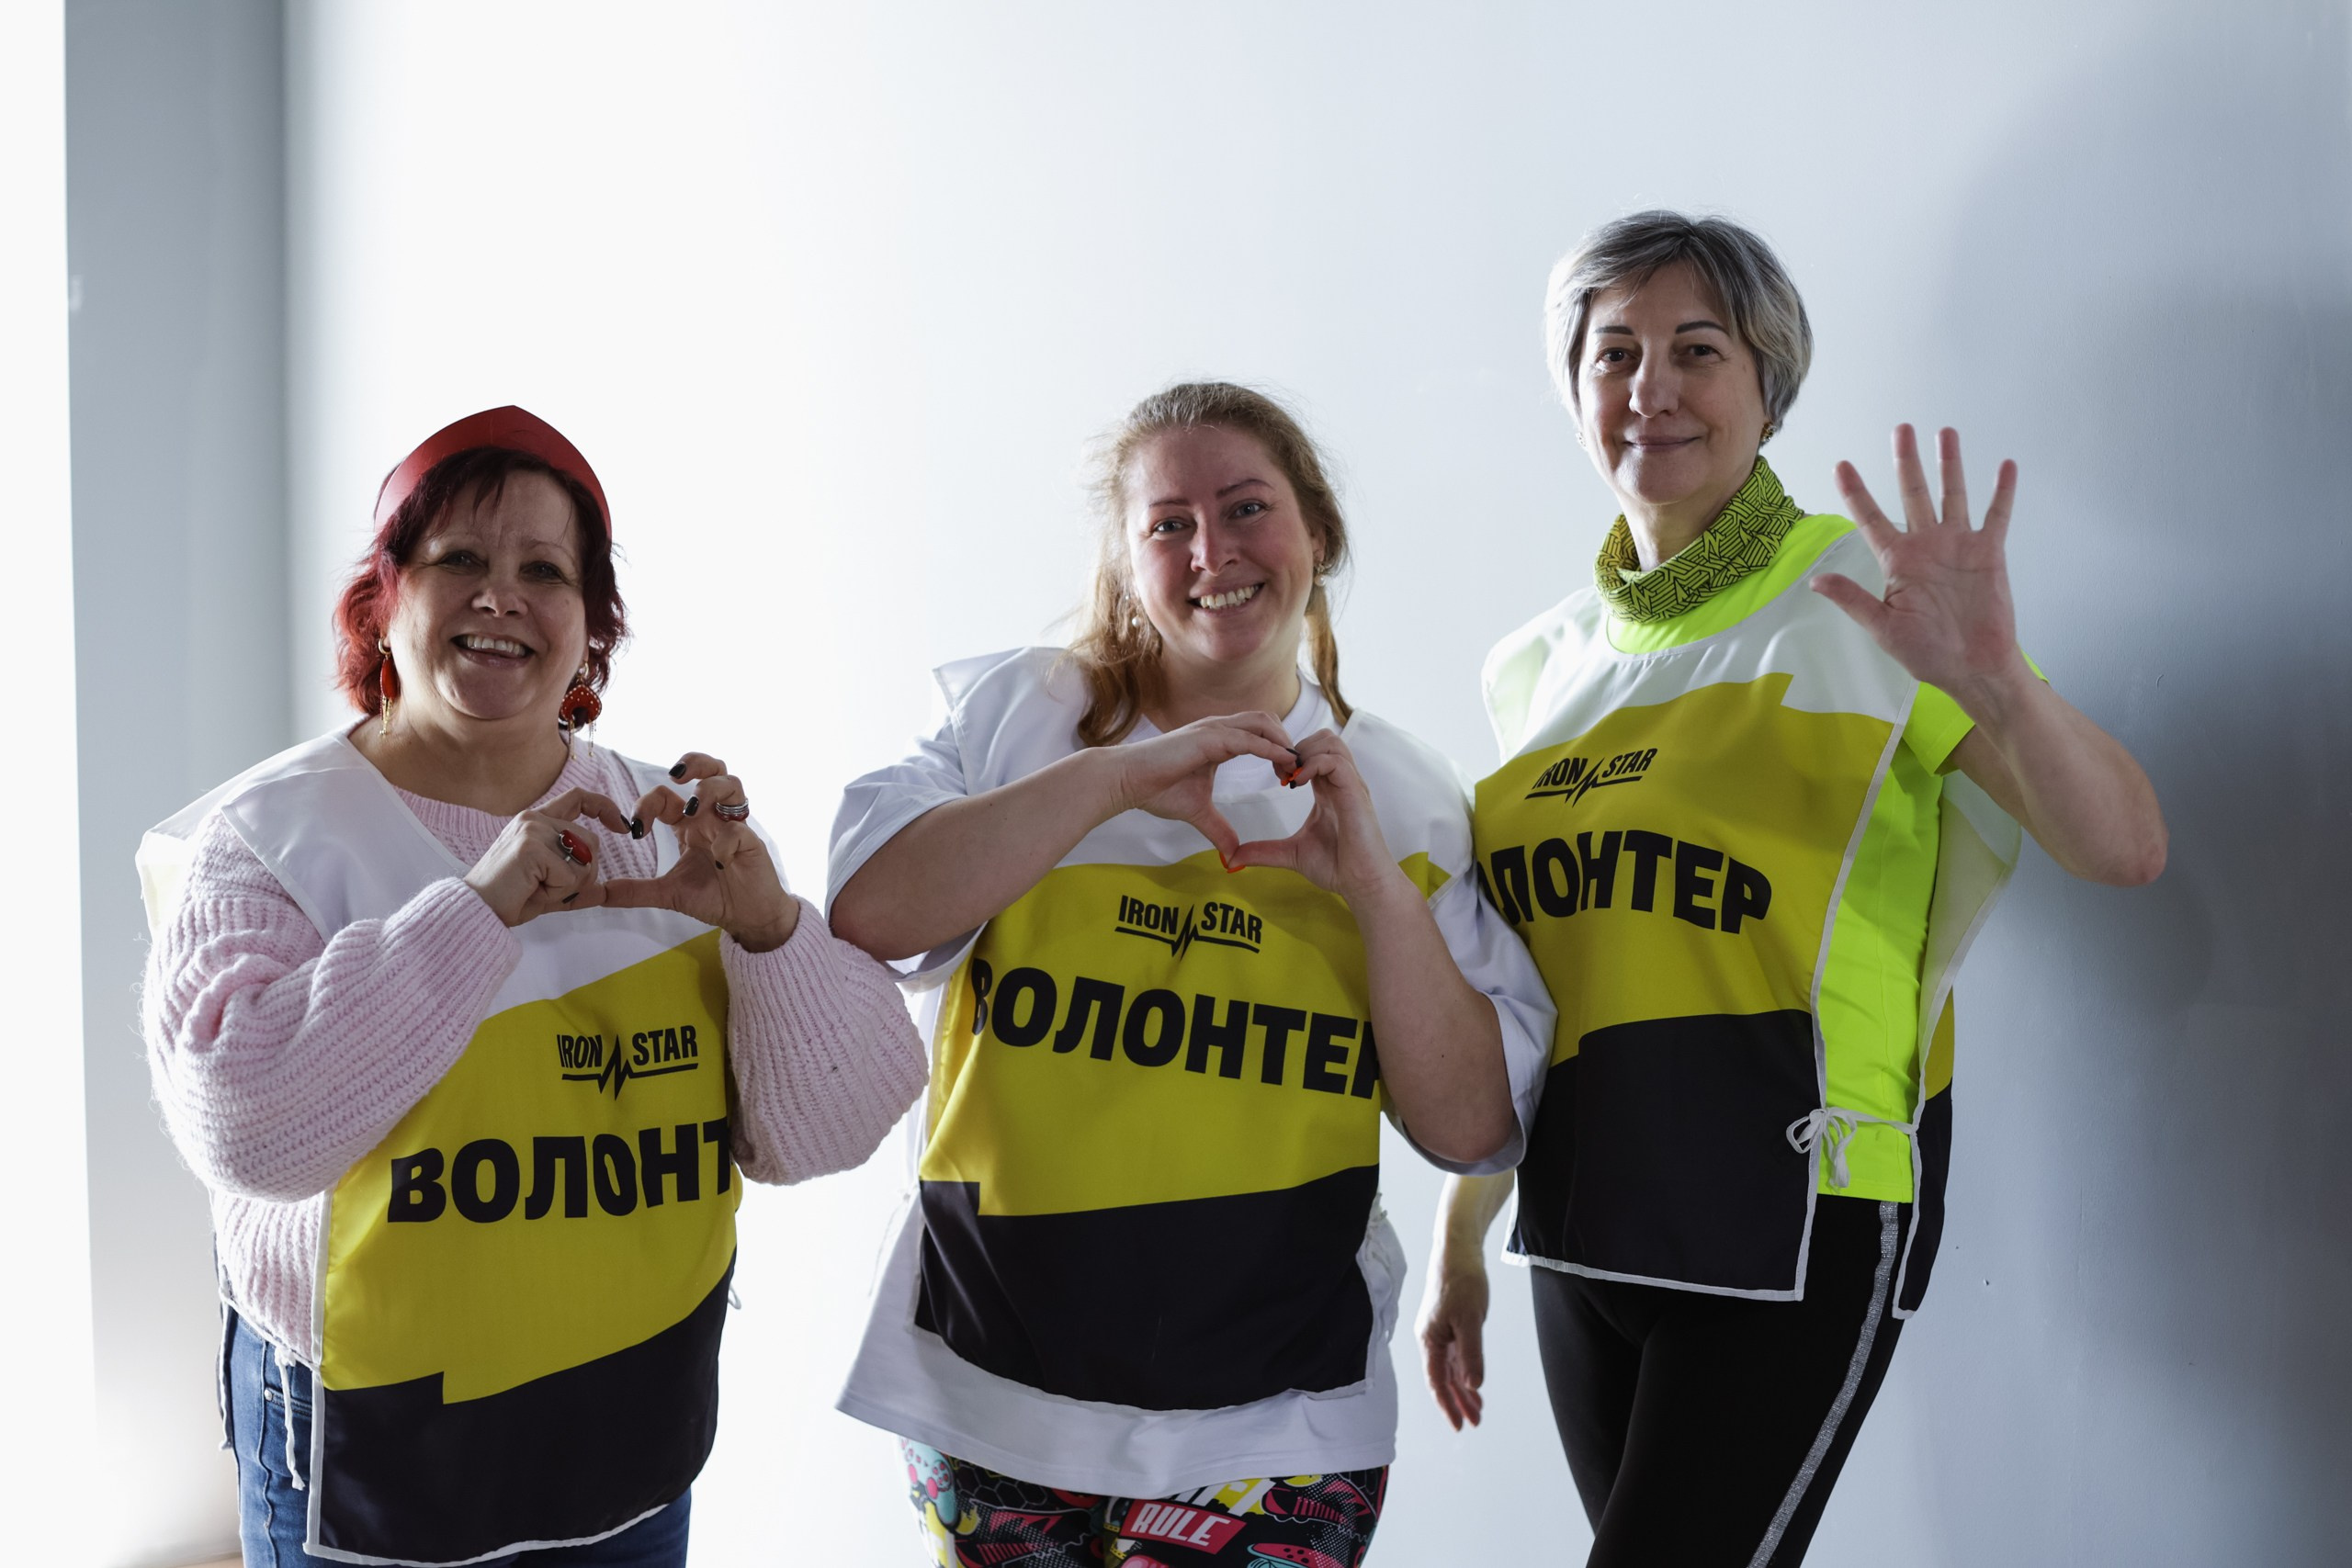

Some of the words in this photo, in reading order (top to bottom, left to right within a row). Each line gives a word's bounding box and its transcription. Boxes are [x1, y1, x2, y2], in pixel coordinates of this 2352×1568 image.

[1532, 757, 1589, 790] IRON
[1601, 747, 1658, 779] STAR
[1117, 894, 1180, 936] IRON
[1200, 900, 1263, 944] STAR
[556, 1033, 603, 1069] IRON
[631, 1024, 698, 1066] STAR
[1130, 1502, 1231, 1547] RULE
